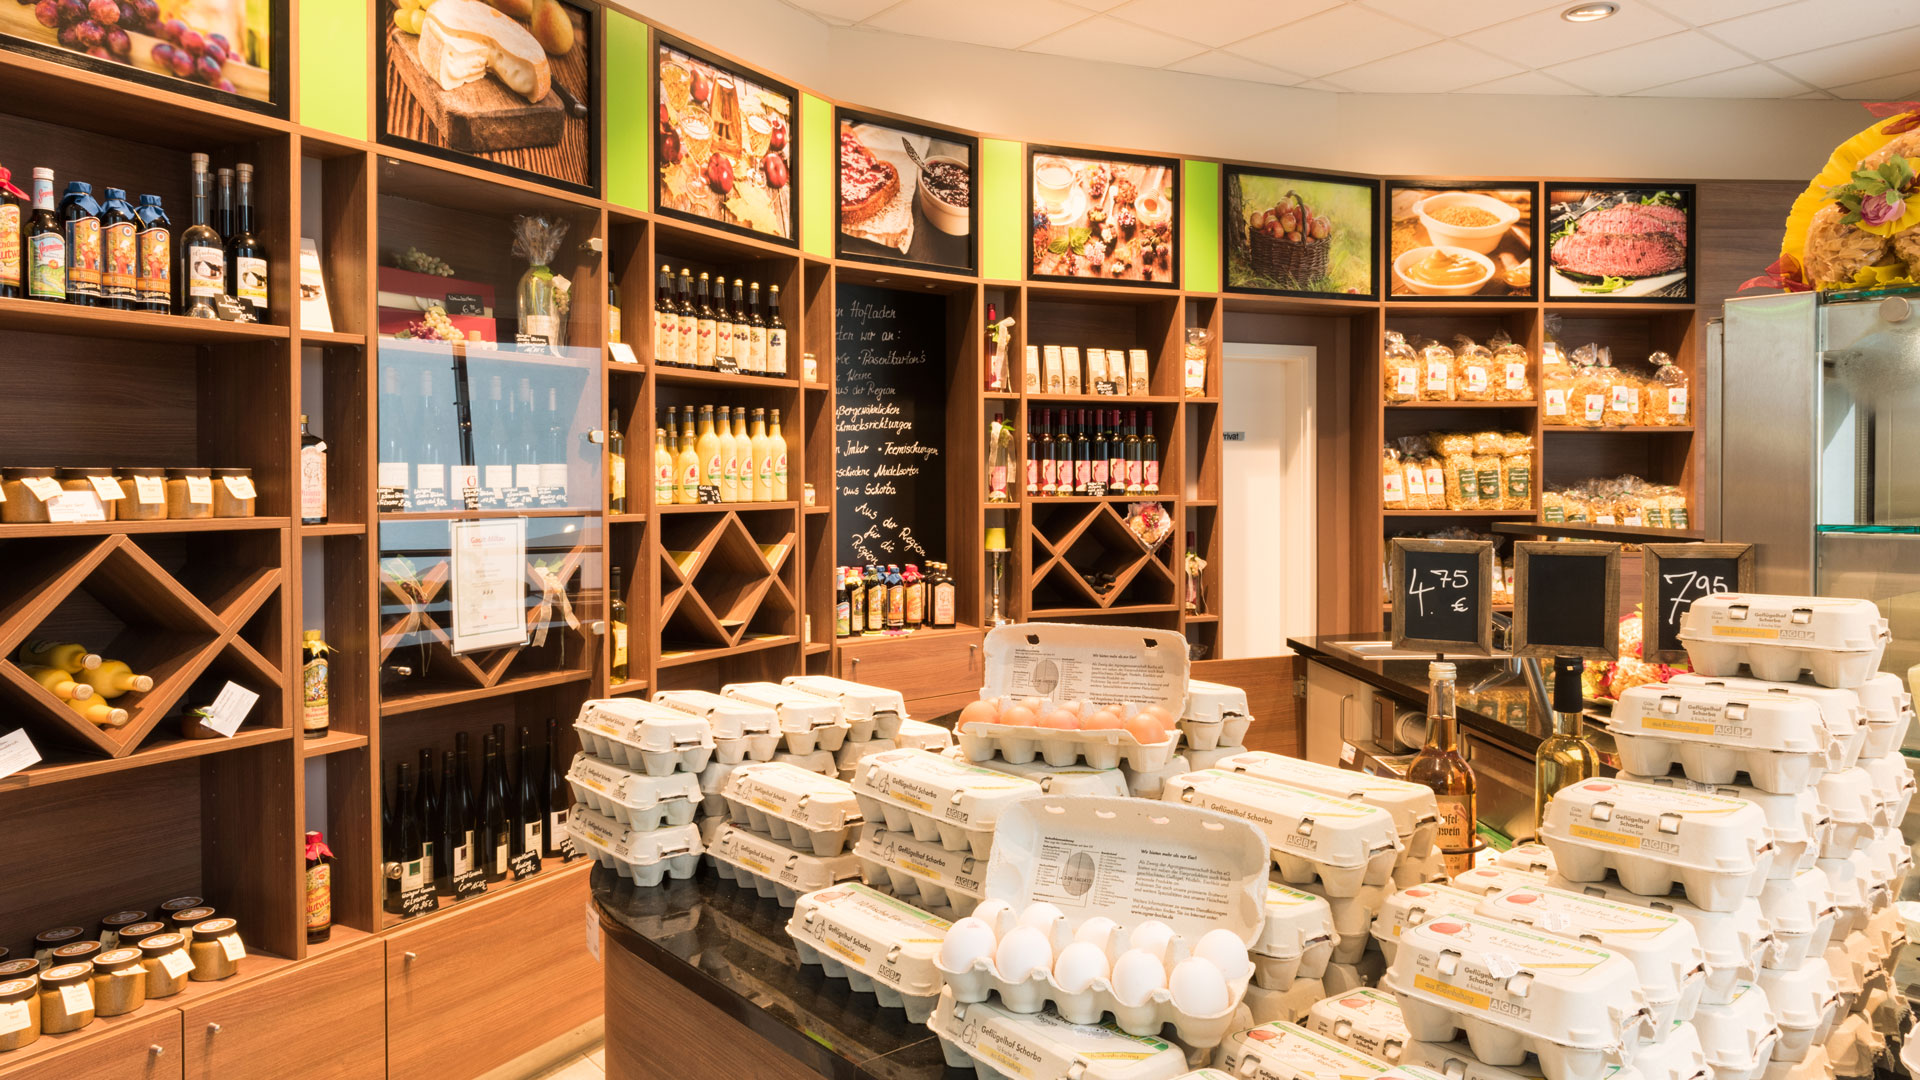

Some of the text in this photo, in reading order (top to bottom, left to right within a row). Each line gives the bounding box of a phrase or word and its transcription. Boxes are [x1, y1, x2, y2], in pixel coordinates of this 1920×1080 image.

[851, 300, 896, 325] Hofladen
[861, 332, 876, 340] wir
[867, 381, 896, 400] Region
[1223, 432, 1239, 440] rivat
[874, 464, 919, 477] Nudelsorten
[843, 486, 859, 496] aus
[855, 502, 925, 556] Aus der Region
[852, 525, 895, 565] für die Region
[1451, 597, 1468, 612] €
[892, 778, 937, 799] Geflügelhof Schorba
[1211, 804, 1272, 824] Geflügelhof Schorba
[1616, 814, 1650, 824] Geflügelhof
[1620, 821, 1643, 829] Schorba
[898, 845, 946, 866] Geflügelhof Schorba
[828, 924, 853, 941] Geflügelhof
[853, 938, 871, 952] Schorba
[1469, 976, 1493, 987] Schorba
[981, 1026, 1041, 1062] Geflügelhof Schorba
